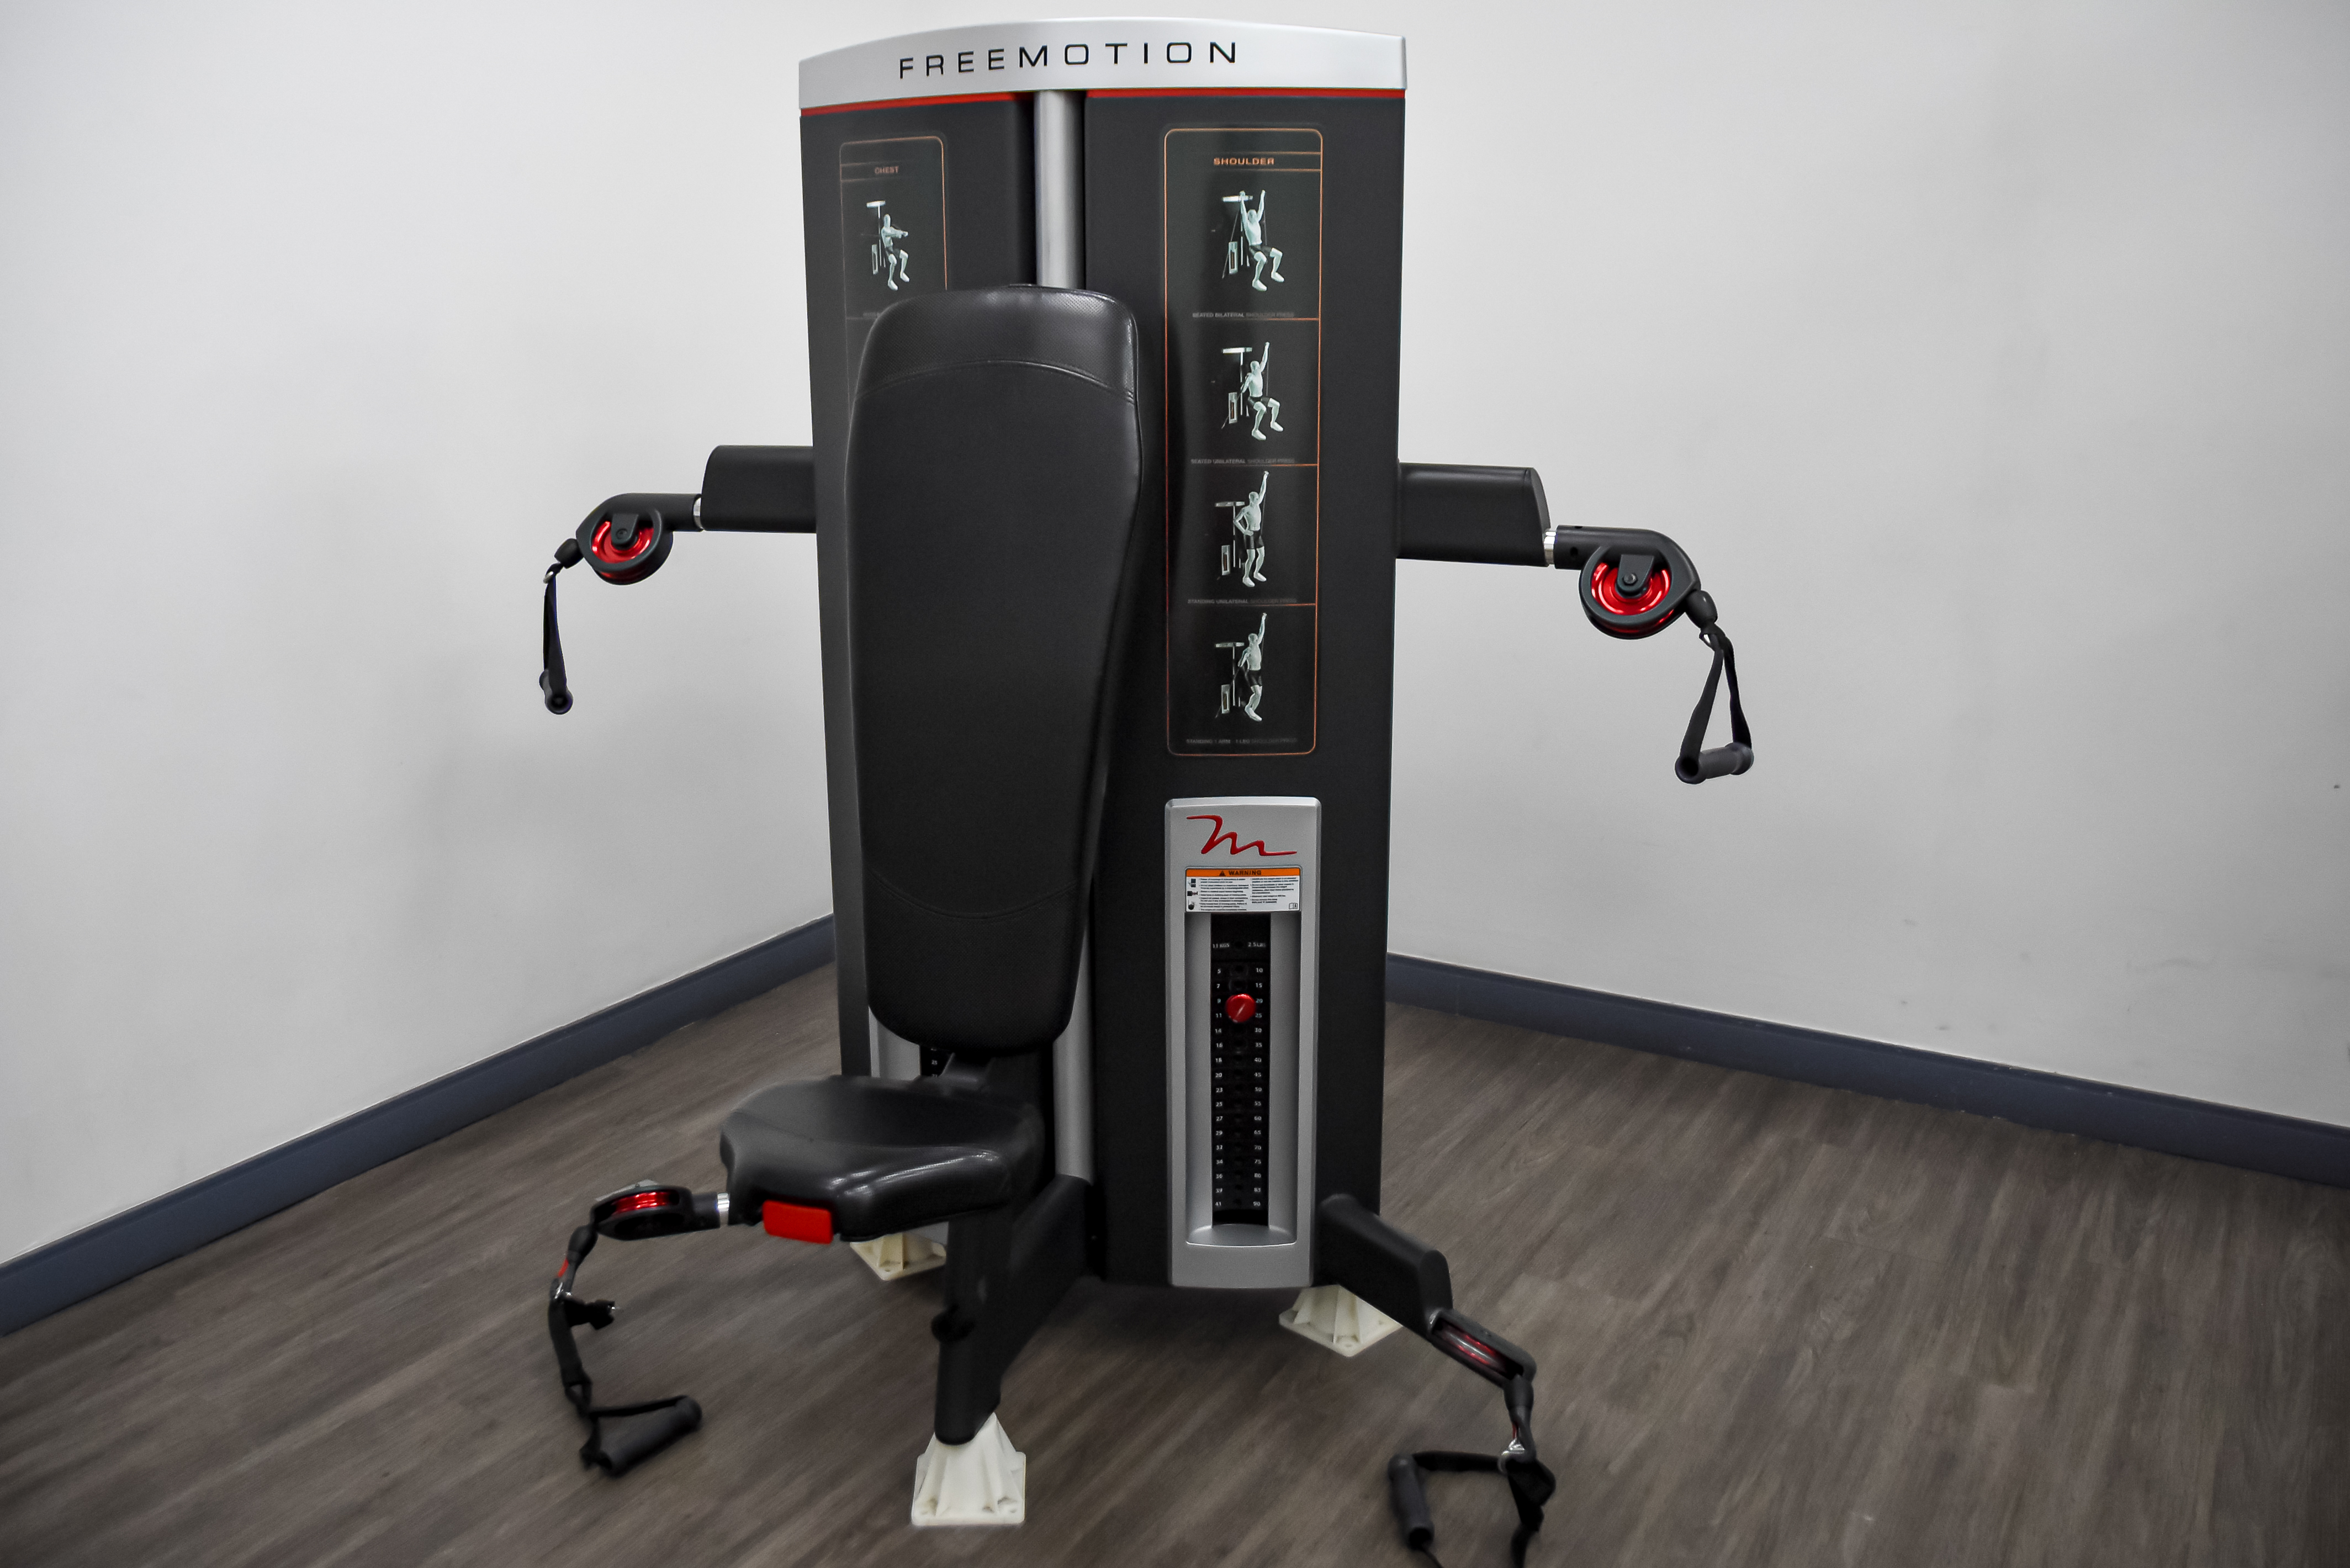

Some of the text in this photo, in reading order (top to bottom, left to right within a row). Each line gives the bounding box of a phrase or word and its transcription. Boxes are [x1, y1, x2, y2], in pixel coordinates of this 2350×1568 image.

[900, 42, 1237, 80] FREEMOTION
[1214, 157, 1274, 166] SHOULDER
[875, 166, 899, 174] CHEST
